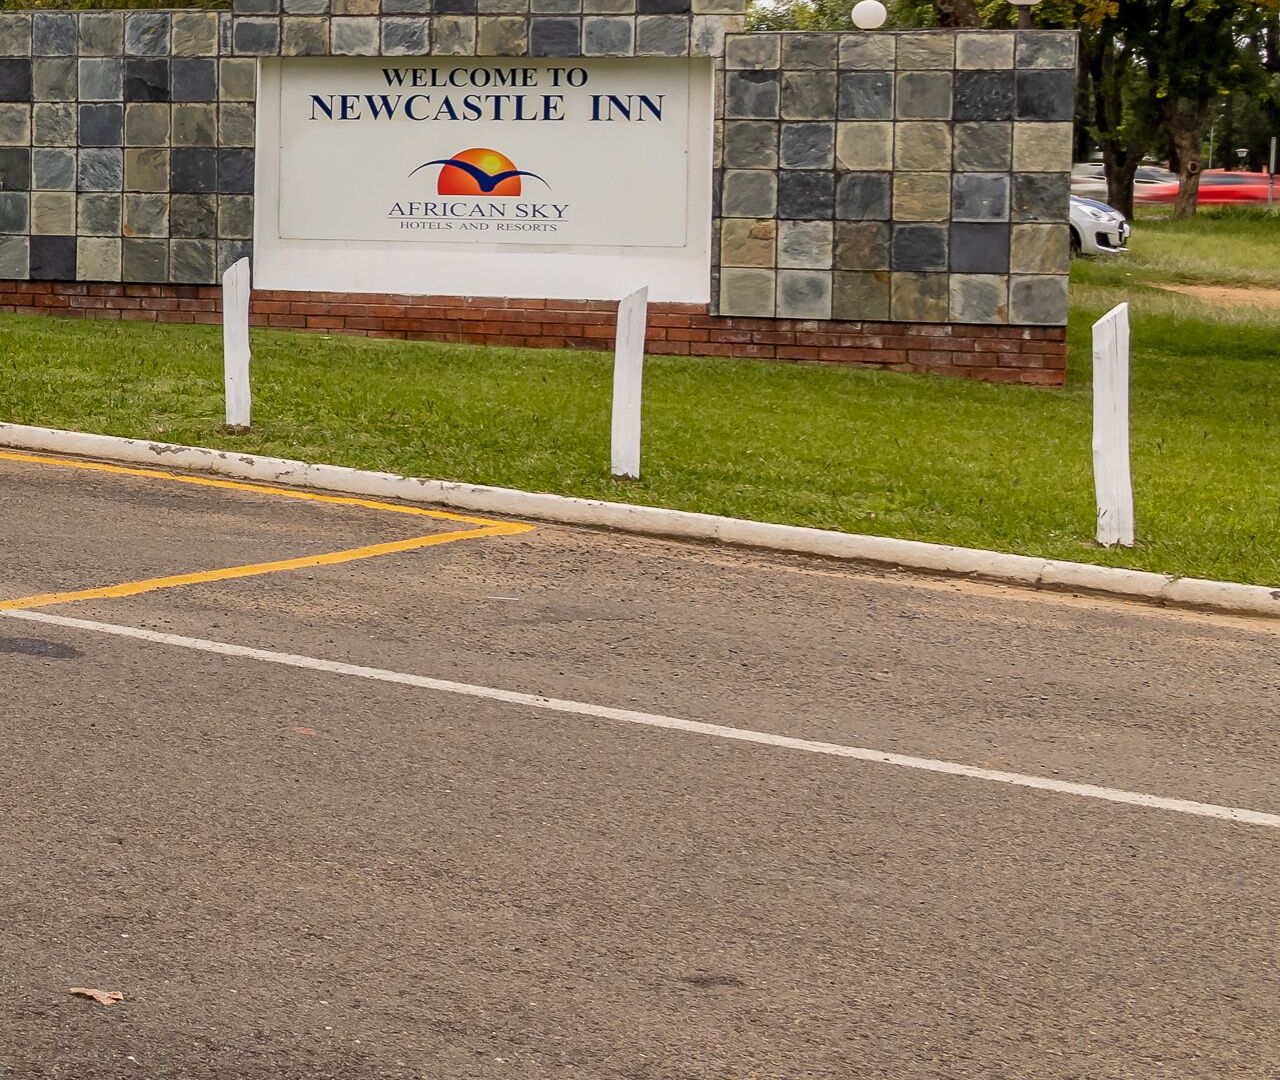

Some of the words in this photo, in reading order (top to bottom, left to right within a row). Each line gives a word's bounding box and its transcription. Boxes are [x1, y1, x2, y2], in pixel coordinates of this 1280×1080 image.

[382, 68, 538, 88] WELCOME
[547, 68, 588, 88] TO
[309, 94, 565, 122] NEWCASTLE
[590, 94, 665, 122] INN
[388, 201, 507, 218] AFRICAN
[515, 203, 570, 219] SKY
[400, 221, 453, 230] HOTELS
[459, 222, 489, 231] AND
[496, 223, 558, 232] RESORTS
